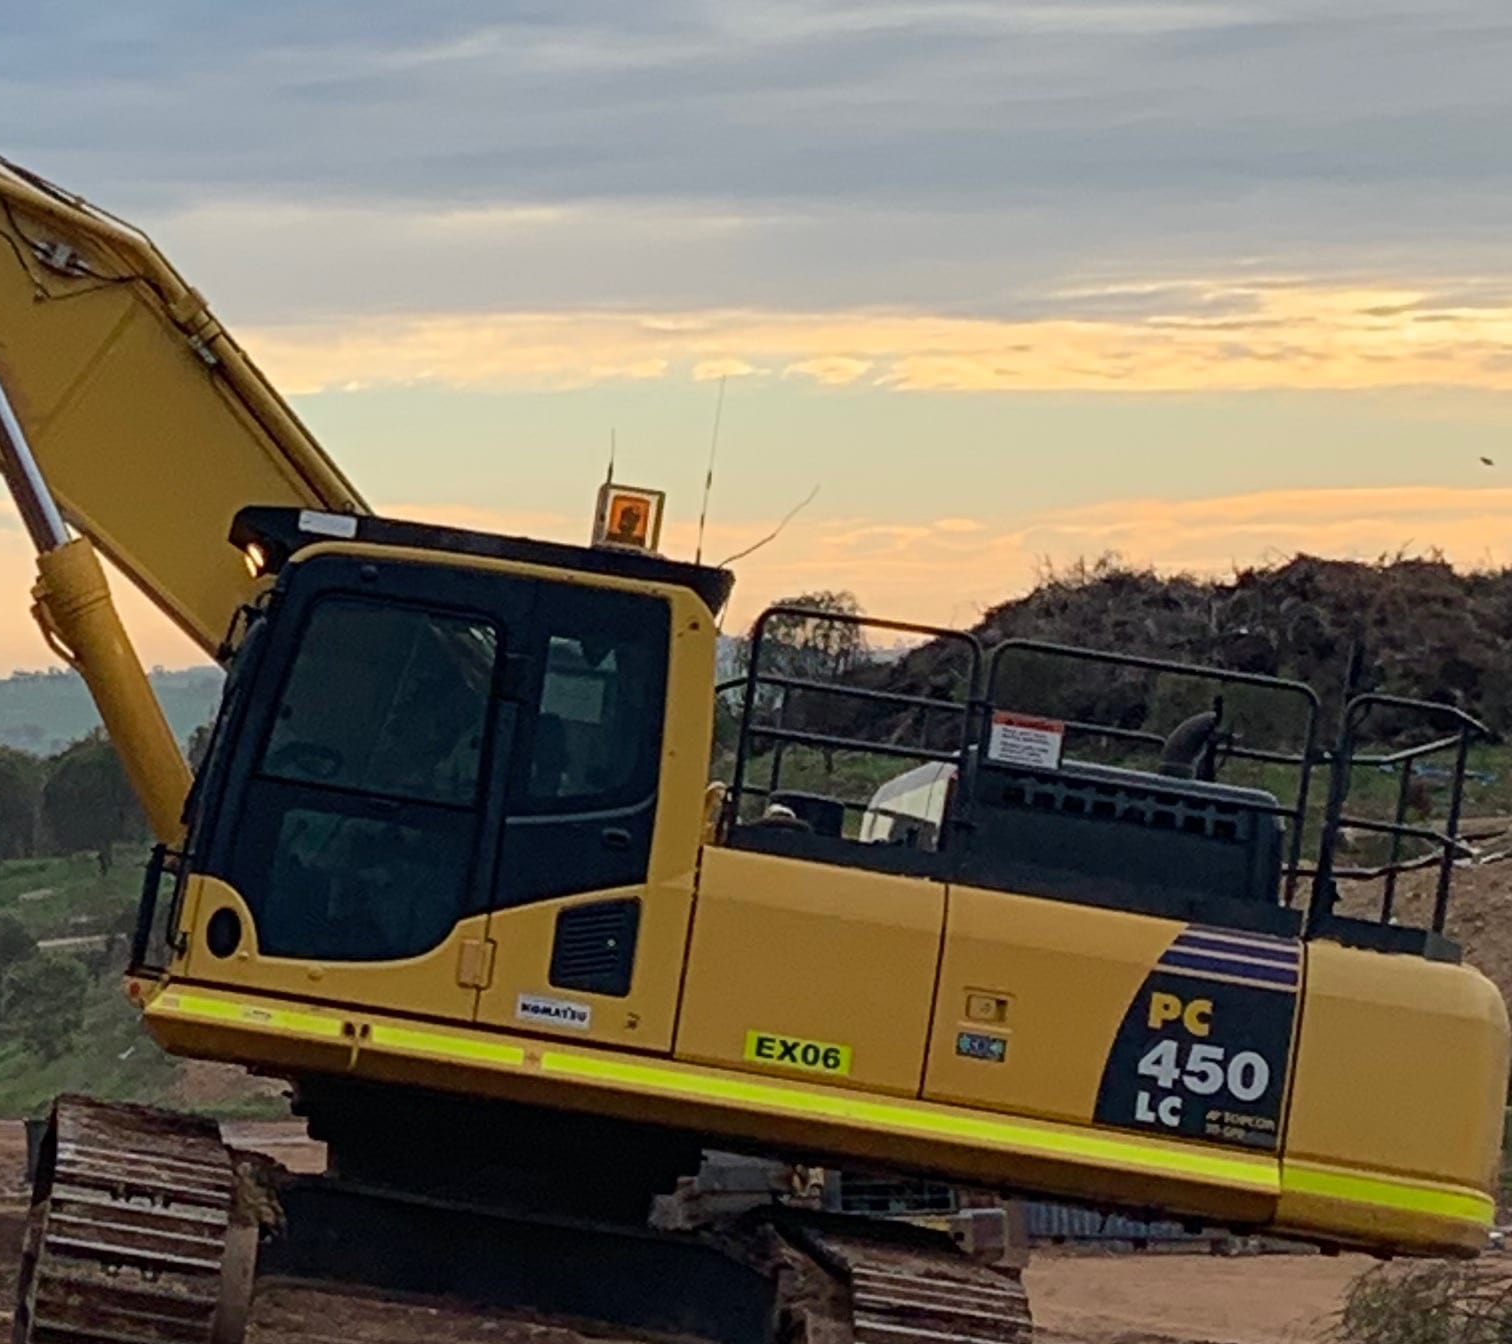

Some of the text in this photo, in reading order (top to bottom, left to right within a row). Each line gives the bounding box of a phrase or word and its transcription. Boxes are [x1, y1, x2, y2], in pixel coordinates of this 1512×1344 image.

[521, 1002, 588, 1023] KOMATSU
[1148, 991, 1214, 1037] PC
[755, 1036, 841, 1070] EX06
[1137, 1039, 1270, 1102] 450
[1134, 1090, 1183, 1127] LC
